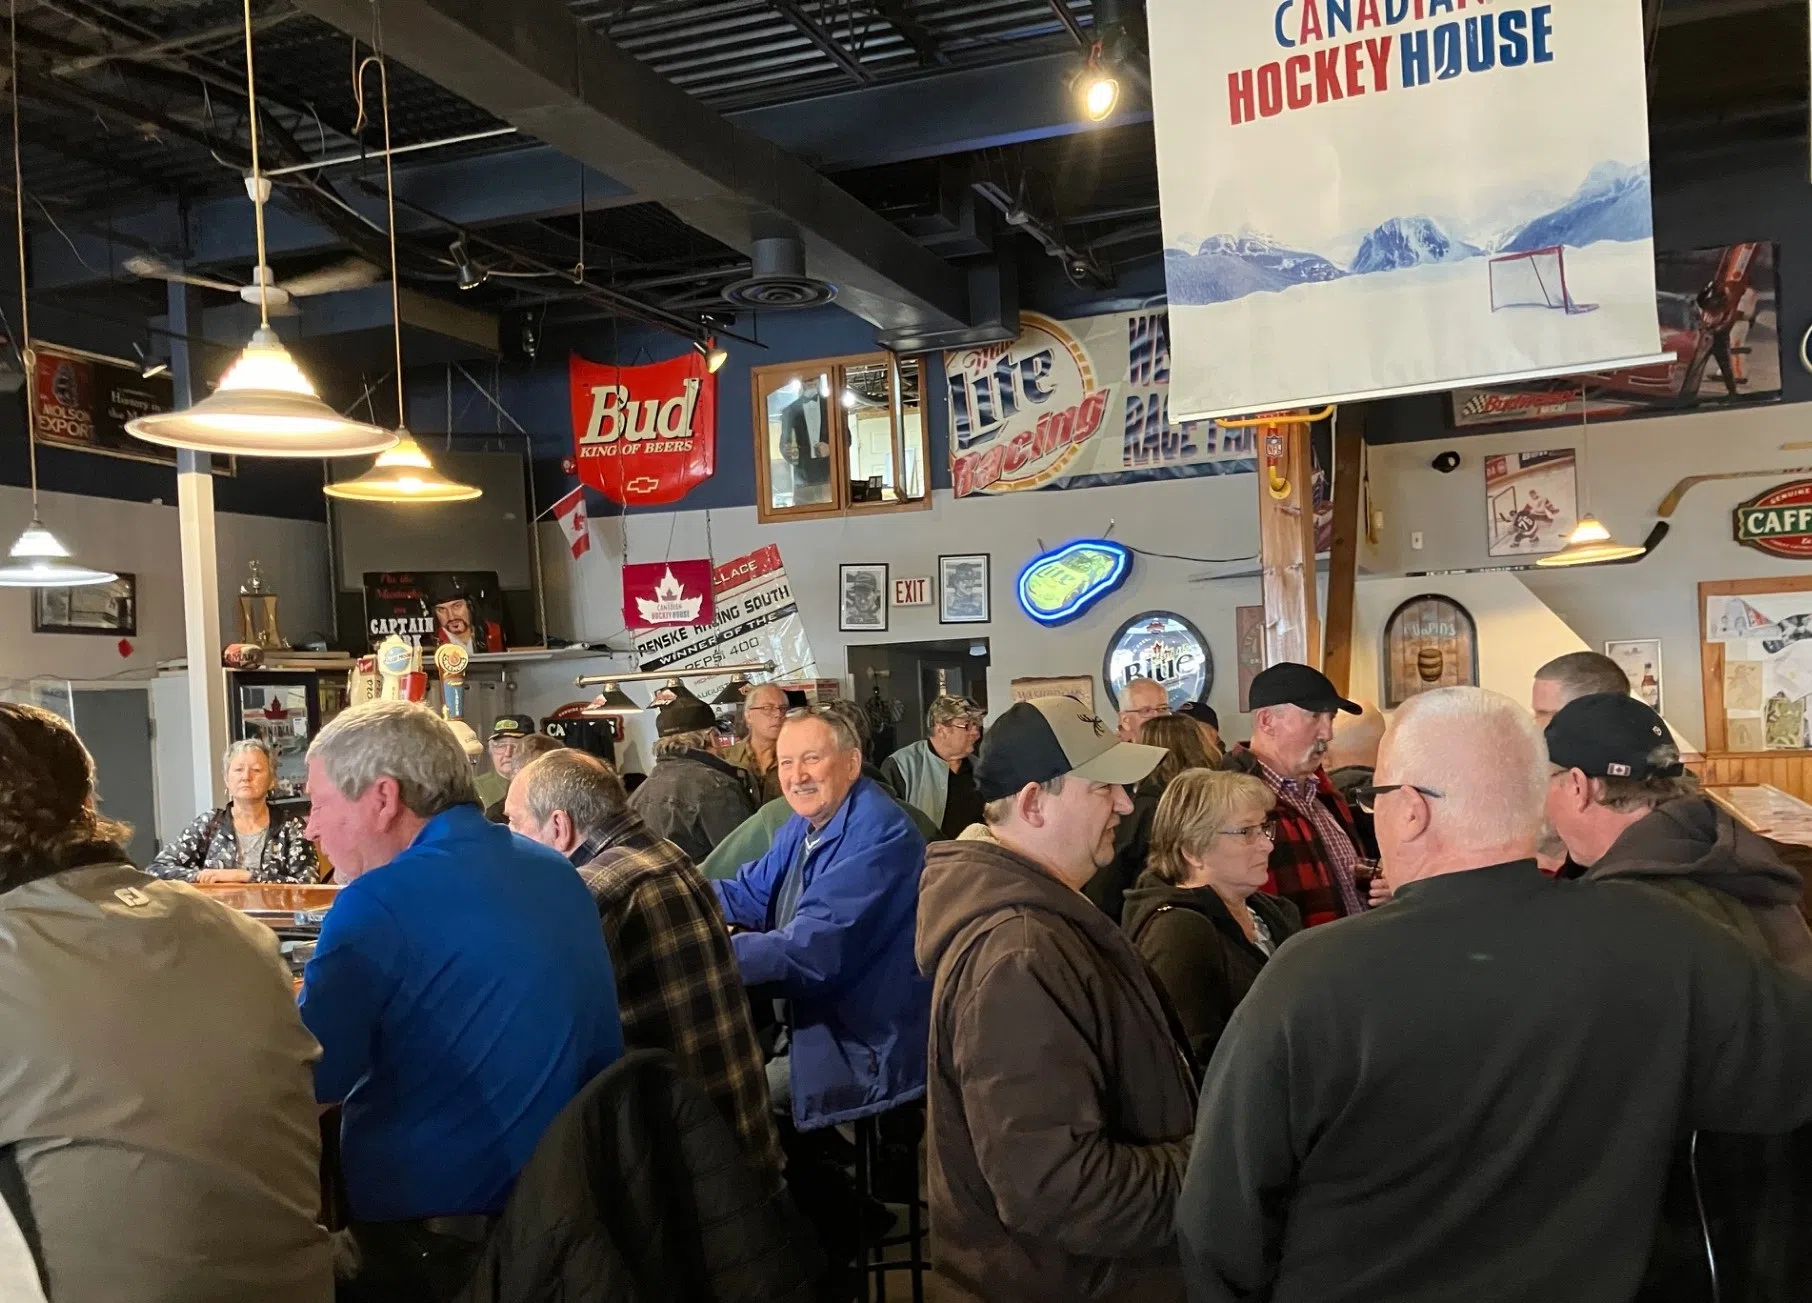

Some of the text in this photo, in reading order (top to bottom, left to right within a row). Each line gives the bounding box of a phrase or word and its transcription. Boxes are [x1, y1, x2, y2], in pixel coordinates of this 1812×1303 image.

[1275, 0, 1485, 48] CANAD
[1228, 5, 1553, 125] HOCKEY HOUSE
[42, 403, 91, 422] MOLSON
[579, 378, 700, 444] Bud
[949, 348, 1057, 449] Lite
[39, 415, 94, 438] EXPORT
[580, 441, 693, 457] KING OF BEERS
[896, 580, 925, 603] EXIT
[370, 617, 434, 634] CAPTAIN
[638, 627, 688, 657] PENSKE
[745, 584, 790, 614] SOUTH
[660, 637, 718, 664] WINNER
[723, 627, 742, 640] OF
[750, 612, 779, 629] THE
[730, 637, 760, 656] 400
